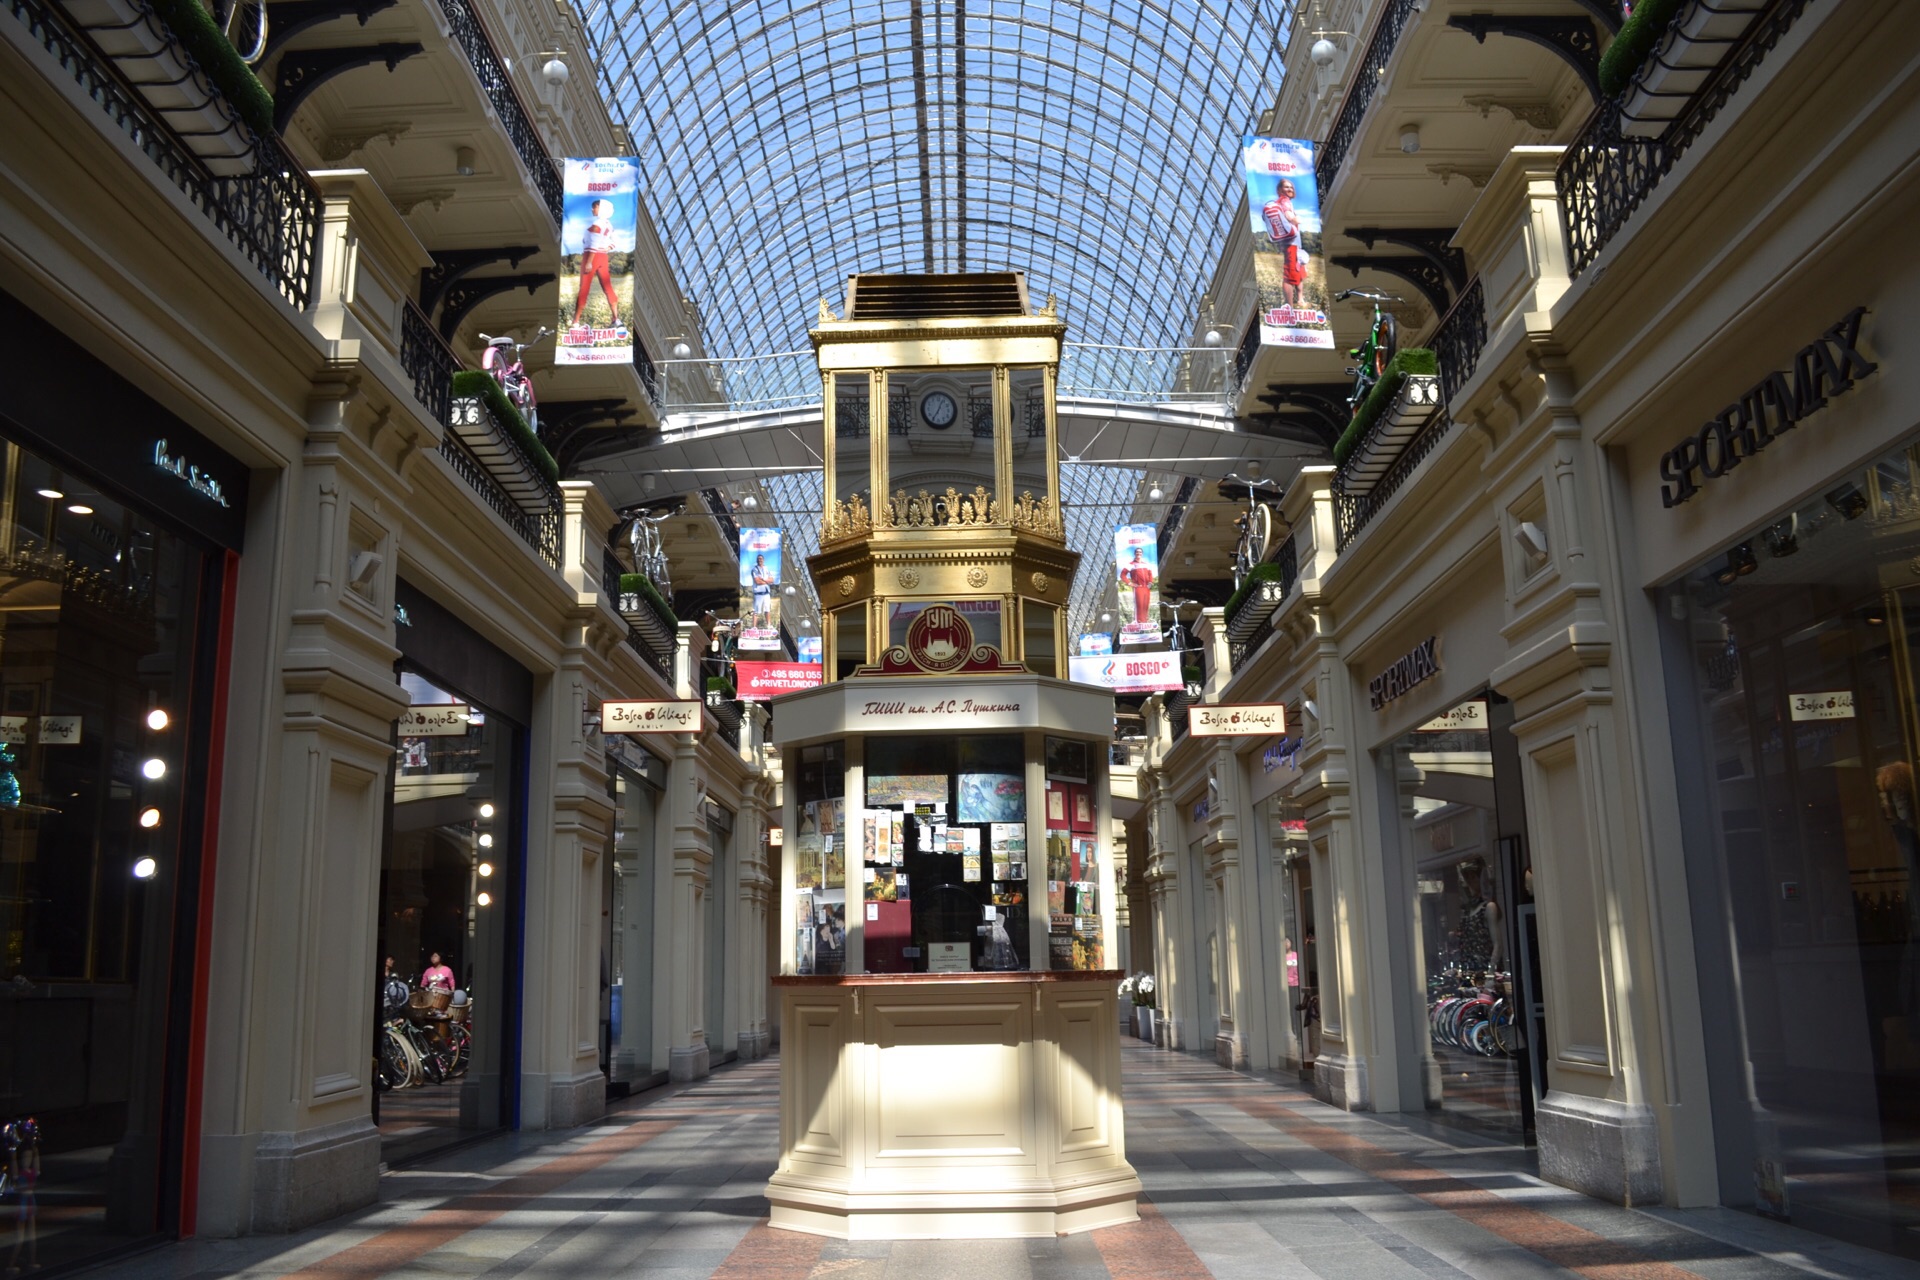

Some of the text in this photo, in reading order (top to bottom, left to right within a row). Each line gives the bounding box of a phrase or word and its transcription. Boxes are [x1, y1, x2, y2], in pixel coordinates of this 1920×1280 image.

[1268, 162, 1290, 172] BOSCO
[588, 182, 611, 191] BOSCO
[1266, 315, 1295, 324] OLYMPIC
[1294, 310, 1316, 321] TEAM
[564, 335, 593, 344] OLYMPIC
[593, 329, 615, 340] TEAM
[1660, 306, 1878, 509] SPORTMAX
[926, 608, 955, 629] ГУМ
[771, 670, 787, 678] 495
[1126, 662, 1160, 676] BOSCO
[1369, 636, 1437, 711] SPORTMAX
[861, 699, 1020, 716] ГМИИ им. А.С. Пушкина
[1795, 697, 1824, 713] Bosco
[612, 707, 692, 725] Bosco Ciliegi
[1200, 711, 1275, 727] Bosco Ciliegi
